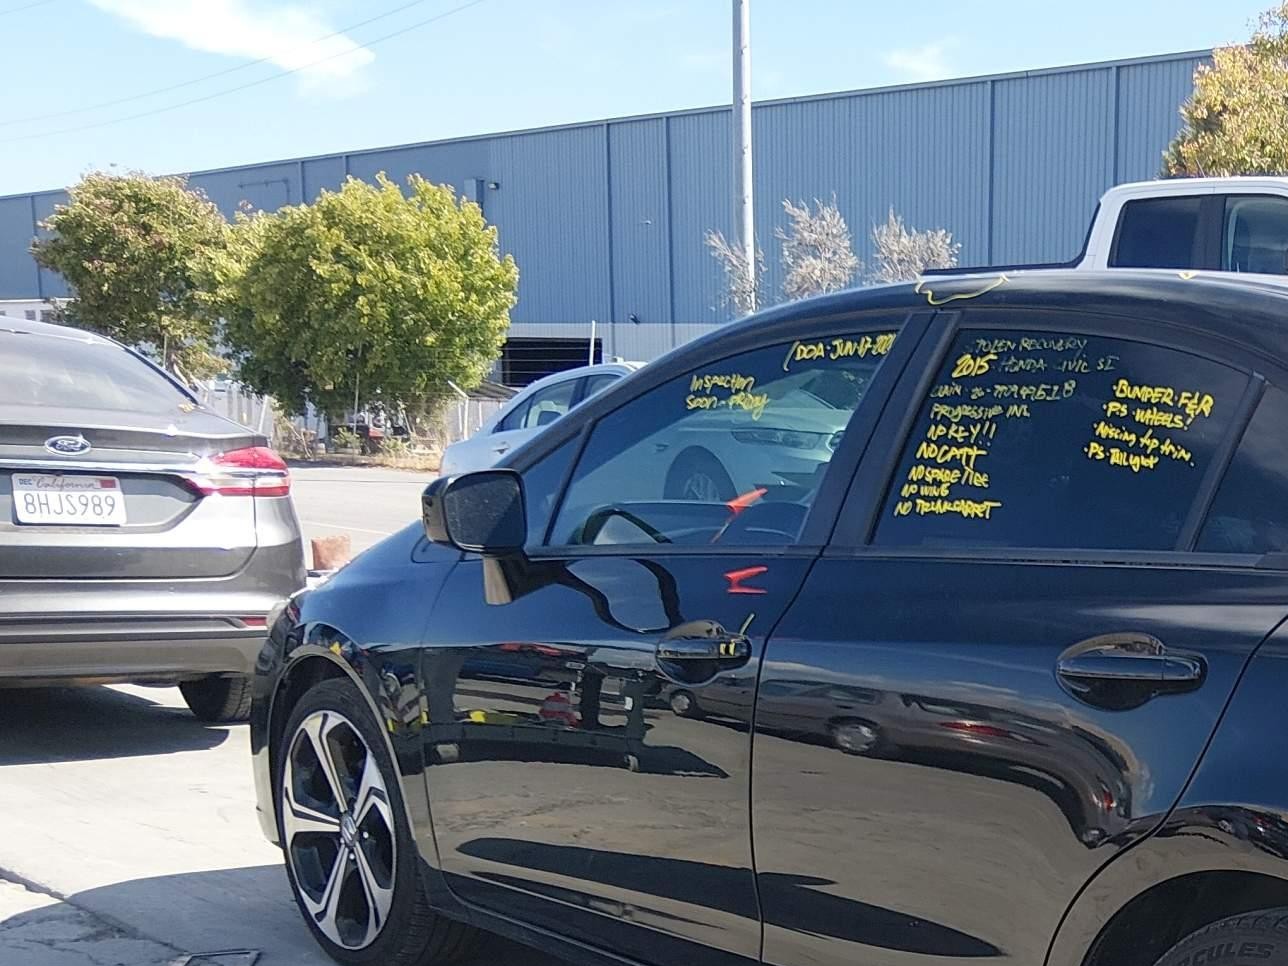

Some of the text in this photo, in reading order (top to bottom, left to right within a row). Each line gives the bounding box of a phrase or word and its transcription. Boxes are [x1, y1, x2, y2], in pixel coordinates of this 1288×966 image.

[950, 353, 998, 378] 2015
[1115, 379, 1173, 406] BUMPER
[24, 493, 116, 517] 8HJS989
